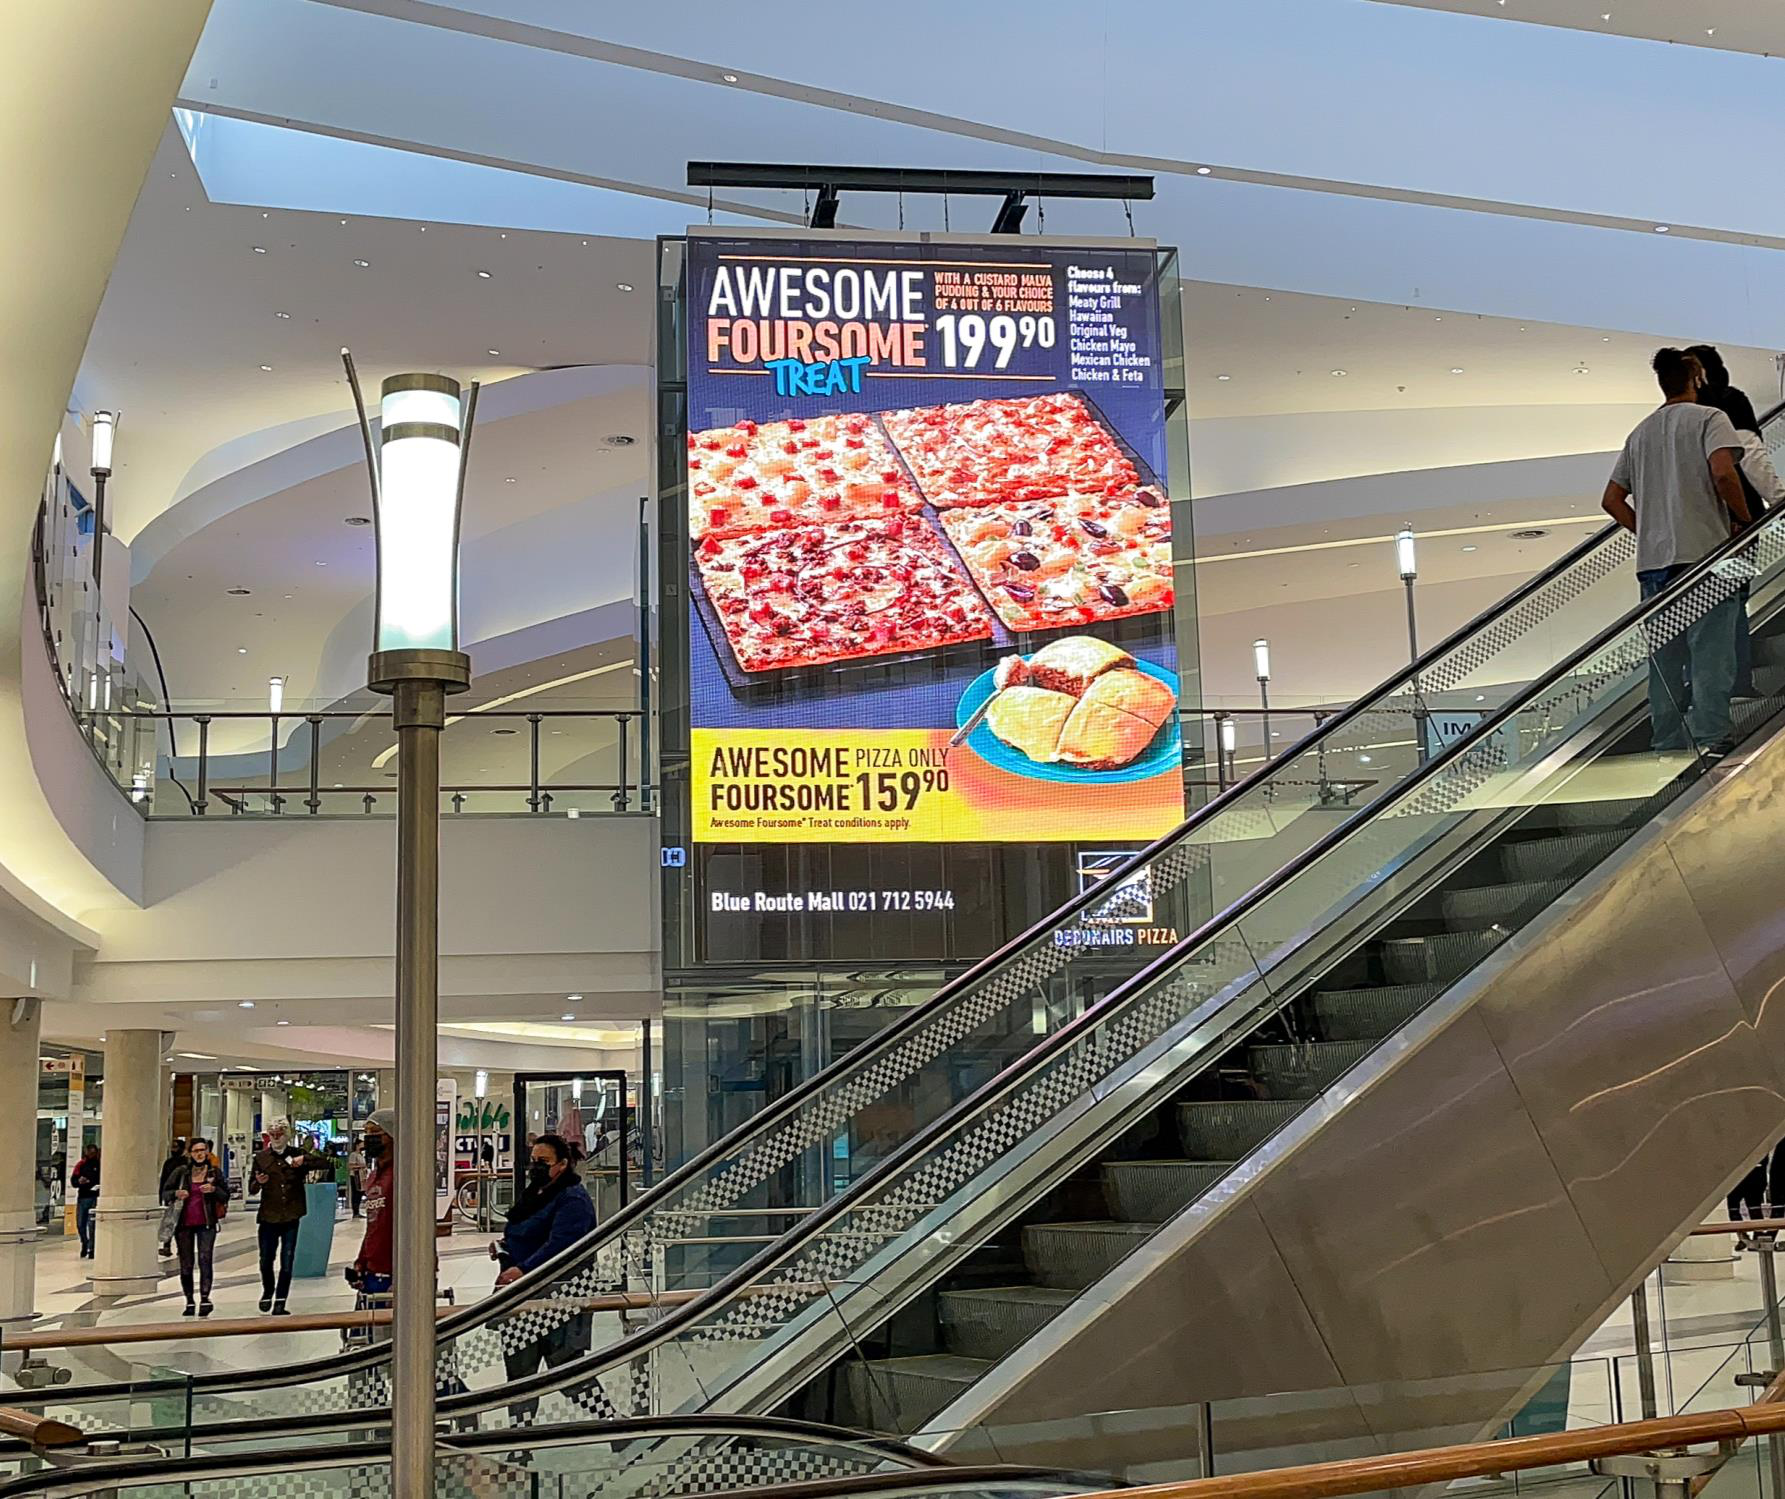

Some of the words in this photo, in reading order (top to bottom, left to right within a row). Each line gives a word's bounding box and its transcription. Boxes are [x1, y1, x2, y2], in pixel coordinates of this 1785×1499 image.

[934, 271, 961, 285] WITH
[963, 272, 972, 285] A
[974, 272, 1018, 287] CUSTARD
[1021, 274, 1053, 287] MALVA
[1067, 265, 1104, 279] Choose
[1106, 266, 1114, 279] 4
[708, 265, 925, 321] AWESOME
[935, 284, 979, 298] PUDDING
[981, 286, 990, 298] &
[991, 286, 1018, 299] YOUR
[1019, 287, 1054, 300] CHOICE
[1068, 280, 1110, 294] flavours
[1112, 281, 1142, 295] from:
[935, 298, 949, 310] OF
[951, 298, 959, 310] 4
[960, 298, 980, 311] OUT
[981, 299, 994, 312] OF
[996, 299, 1003, 312] 6
[1004, 300, 1054, 313] FLAVOURS
[1069, 295, 1098, 310] Meaty
[1099, 295, 1121, 309] Grill
[1069, 309, 1114, 322] Hawaiian
[1070, 323, 1108, 339] Original
[1109, 324, 1128, 339] Veg
[707, 318, 926, 367] FOURSOME
[1071, 338, 1109, 352] Chicken
[1110, 339, 1137, 355] Mayo
[1071, 352, 1112, 366] Mexican
[1113, 353, 1151, 367] Chicken
[765, 355, 872, 397] TREAT
[1072, 368, 1110, 381] Chicken
[1112, 368, 1121, 381] &
[1122, 368, 1144, 382] Feta
[710, 747, 850, 778] AWESOME
[856, 748, 902, 768] PIZZA
[908, 748, 949, 768] ONLY
[711, 784, 851, 811] FOURSOME
[710, 817, 754, 829] Awesome
[809, 817, 832, 828] Treat
[834, 817, 882, 829] conditions
[884, 817, 911, 831] apply.
[711, 892, 750, 911] Blue
[754, 892, 803, 911] Route
[808, 891, 844, 911] Mall
[849, 891, 876, 911] 021
[882, 890, 910, 910] 712
[914, 890, 954, 910] 5944
[1137, 928, 1178, 945] PIZZA
